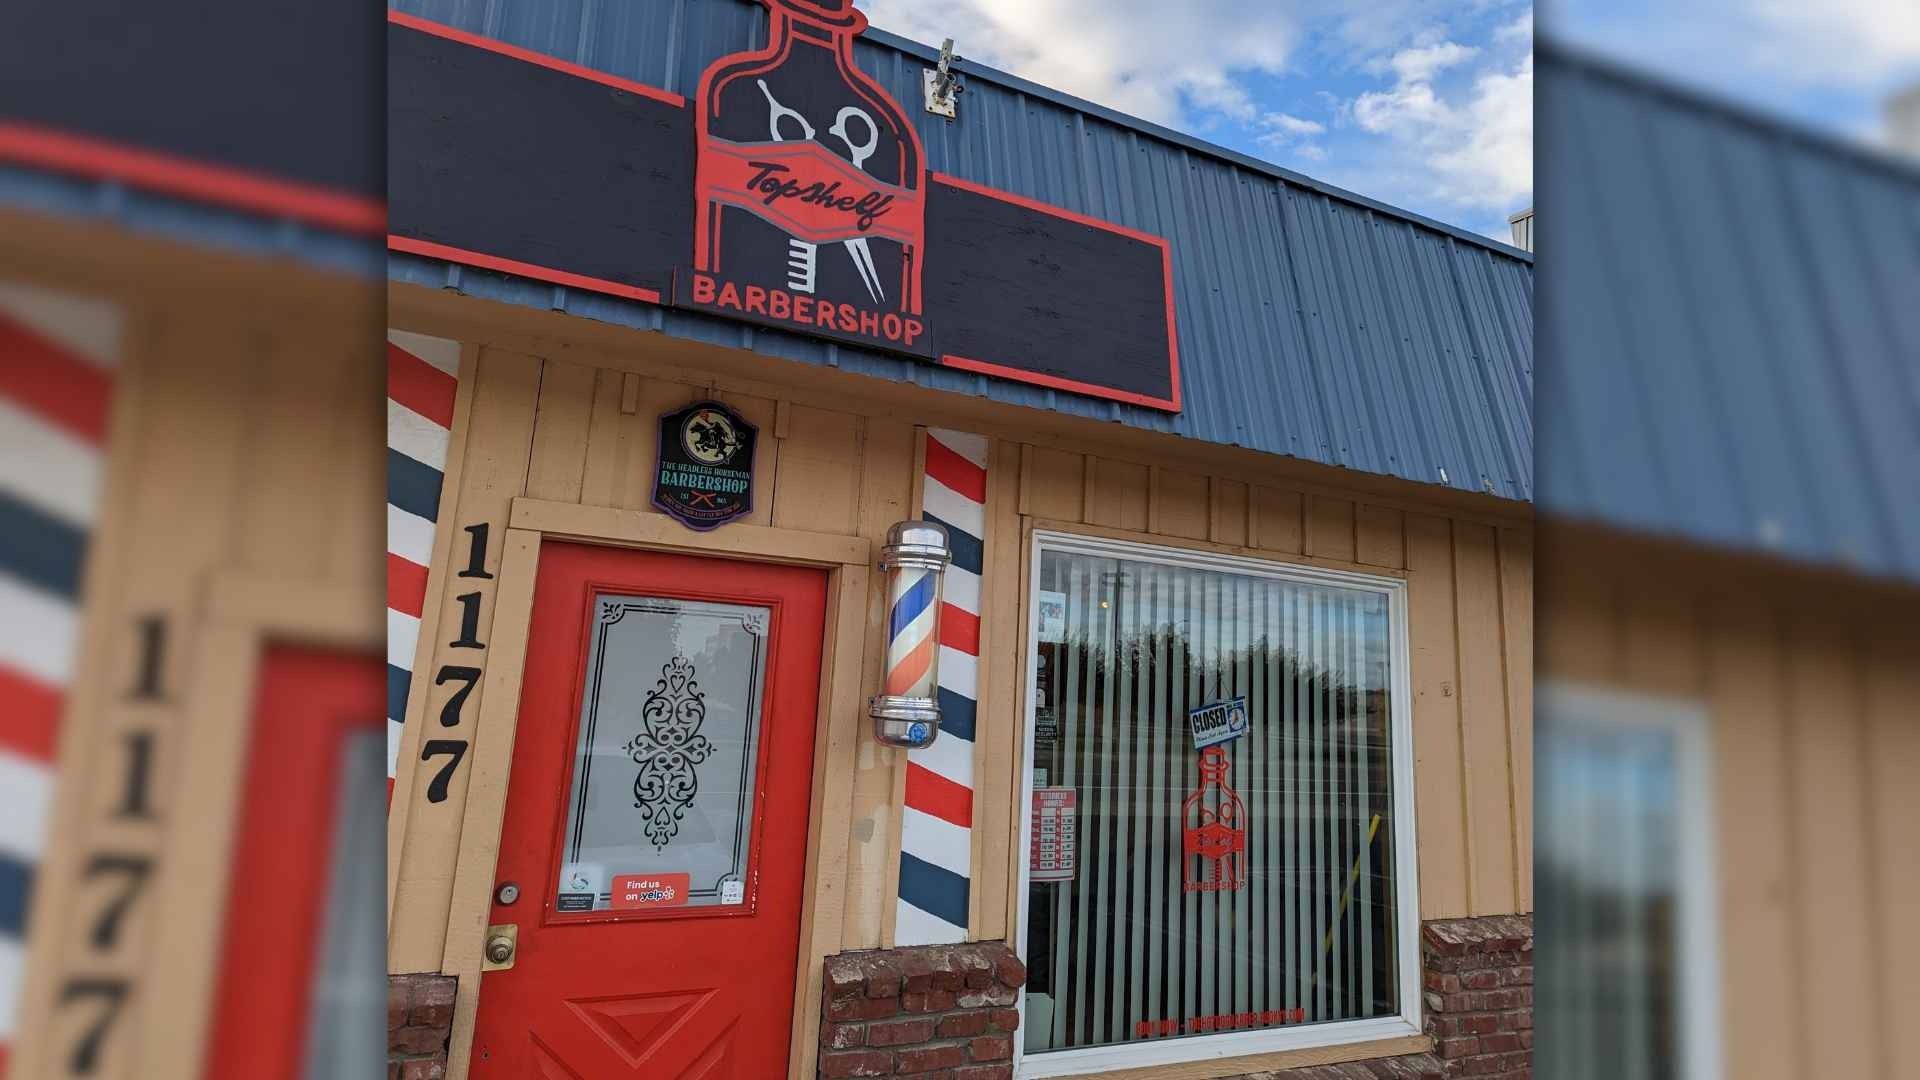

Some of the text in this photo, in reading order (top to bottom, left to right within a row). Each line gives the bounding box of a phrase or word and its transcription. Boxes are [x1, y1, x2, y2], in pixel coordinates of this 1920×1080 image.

[692, 273, 924, 346] BARBERSHOP
[662, 461, 676, 471] THE
[661, 470, 748, 494] BARBERSHOP
[421, 522, 494, 804] 1177
[1192, 707, 1227, 734] CLOSED
[625, 890, 664, 903] on yelp
[626, 880, 647, 889] Find
